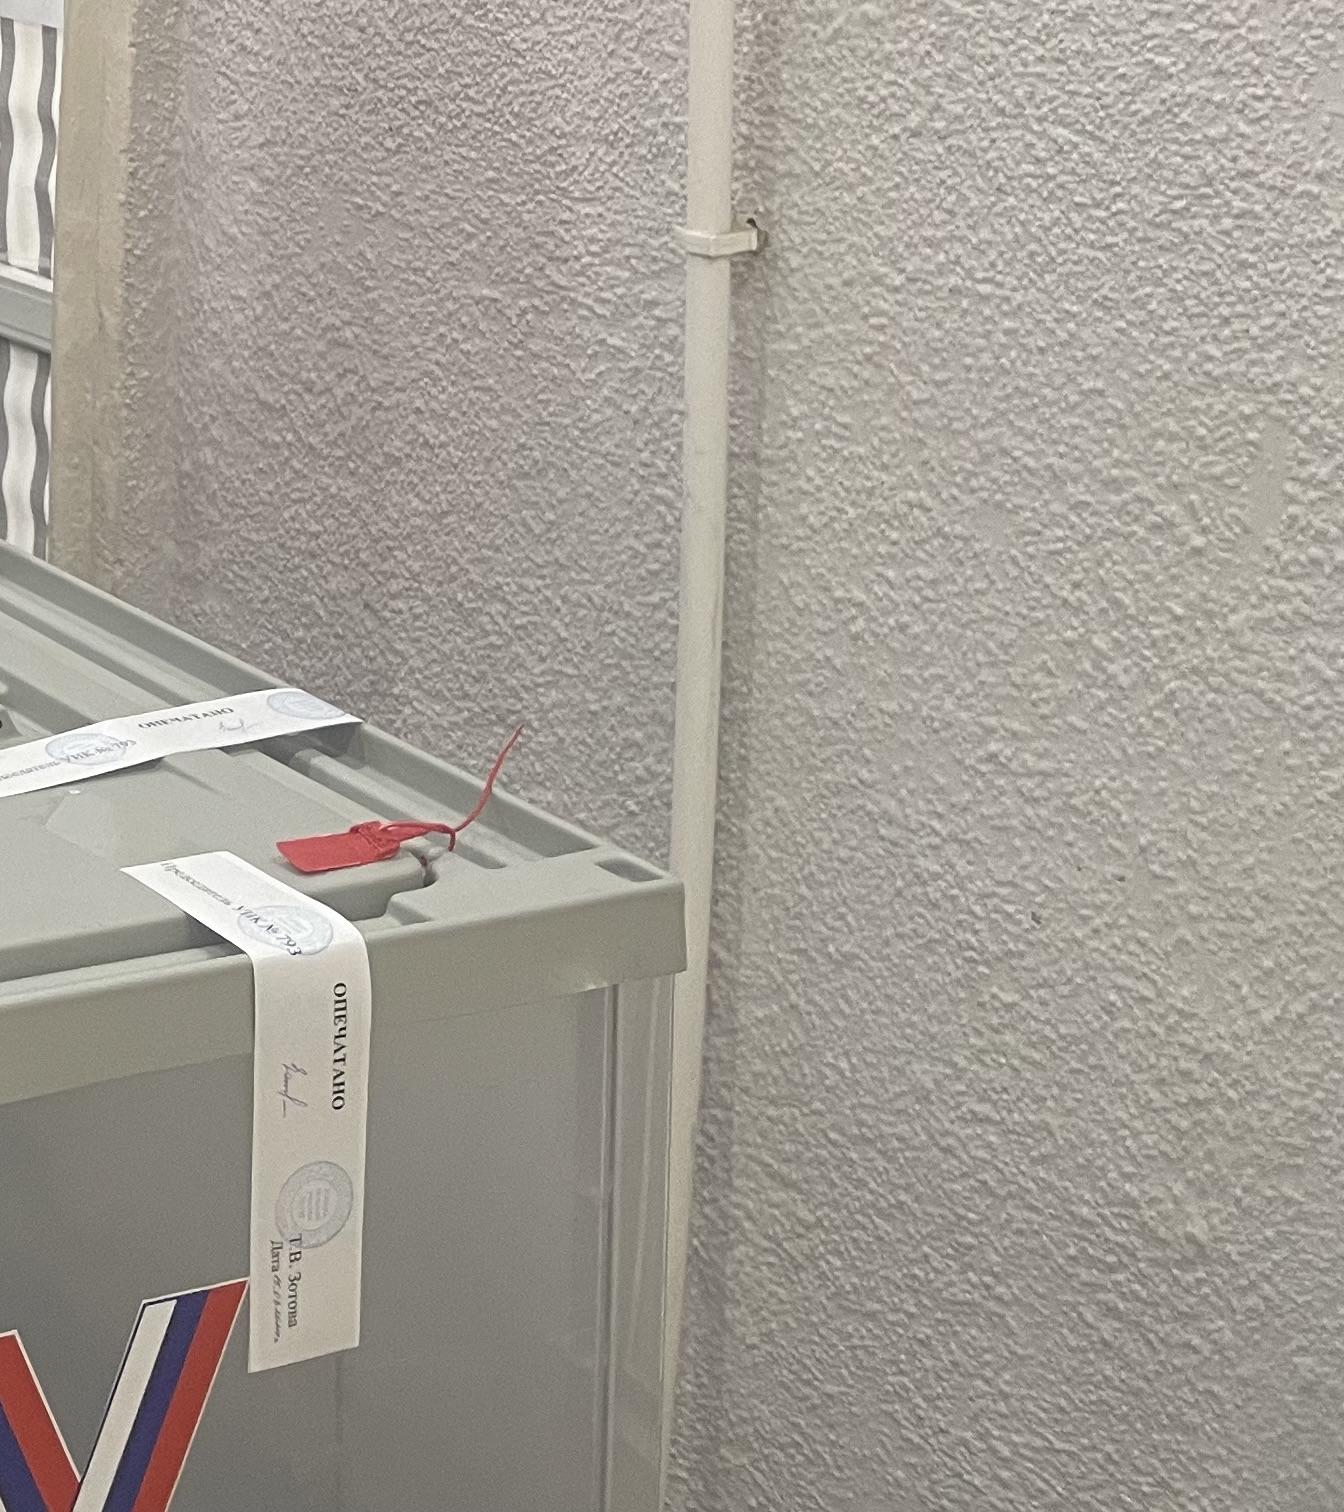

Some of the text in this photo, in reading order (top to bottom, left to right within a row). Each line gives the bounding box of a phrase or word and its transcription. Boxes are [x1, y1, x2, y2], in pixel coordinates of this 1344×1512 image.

[138, 707, 235, 730] ОПЕЧАТАНО
[330, 982, 348, 1112] ОПЕЧАТАНО
[270, 1240, 284, 1273] Дата
[288, 1271, 302, 1327] Зотова
